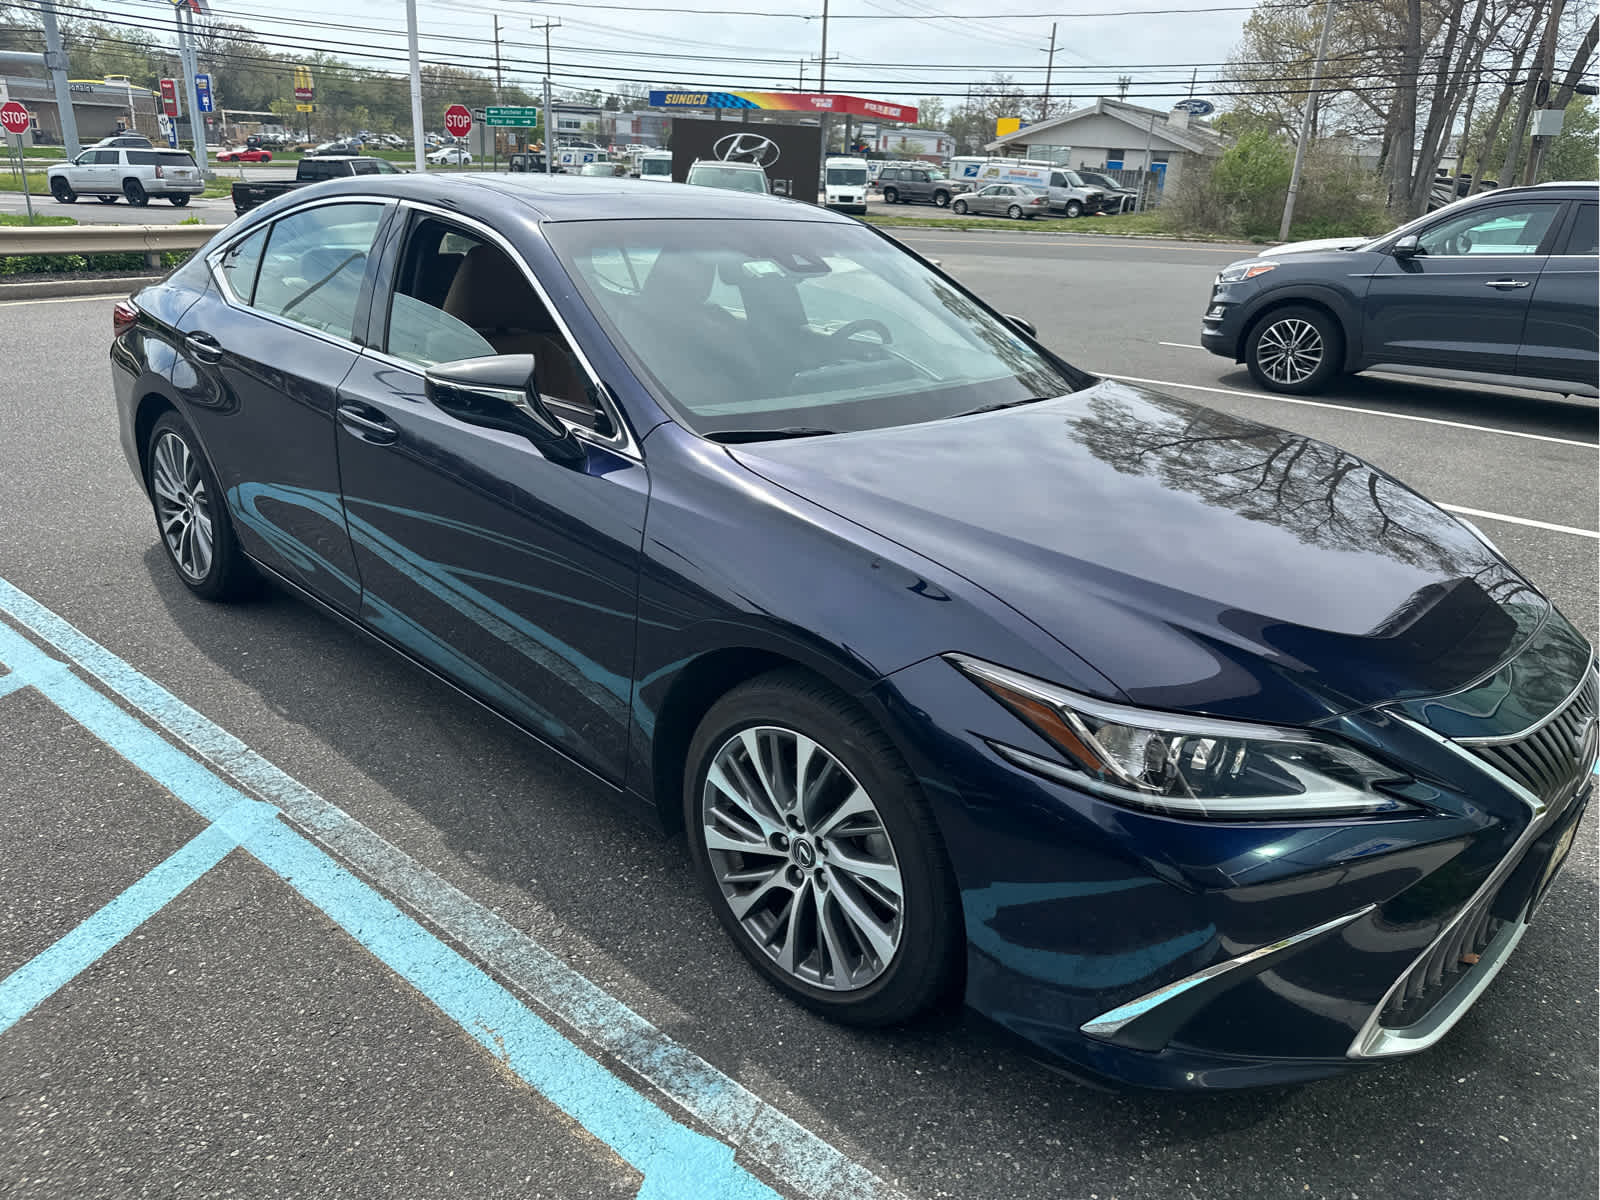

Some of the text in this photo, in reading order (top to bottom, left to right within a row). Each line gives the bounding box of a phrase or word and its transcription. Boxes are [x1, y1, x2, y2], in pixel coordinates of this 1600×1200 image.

[664, 93, 708, 105] SUNOCO
[1, 111, 27, 125] STOP
[446, 114, 470, 128] STOP
